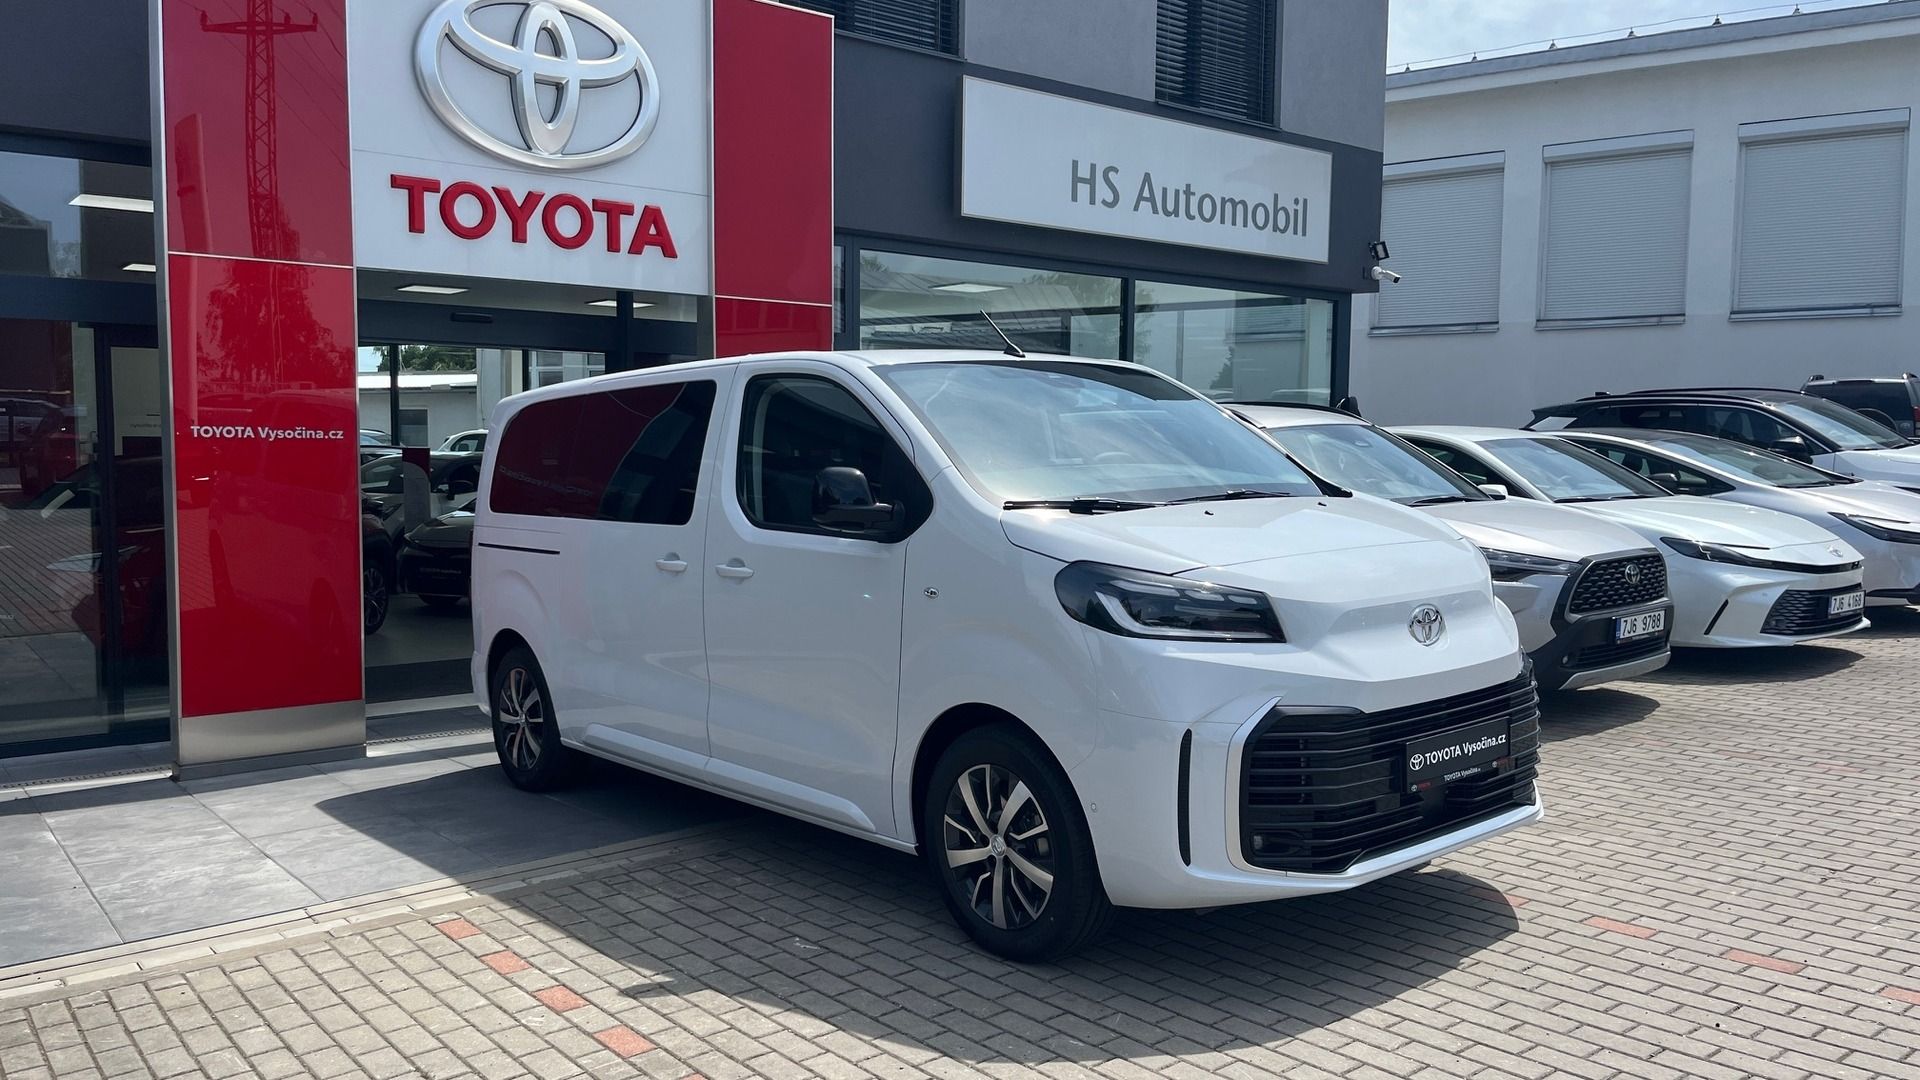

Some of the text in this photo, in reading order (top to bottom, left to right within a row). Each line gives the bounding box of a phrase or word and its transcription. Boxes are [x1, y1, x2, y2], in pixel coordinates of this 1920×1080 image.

[1071, 159, 1308, 237] HS Automobil
[390, 173, 678, 259] TOYOTA
[191, 425, 344, 441] TOYOTA Vysočina.cz
[1832, 596, 1845, 612] 7J6
[1622, 612, 1661, 637] 7J6 9788
[1425, 734, 1507, 765] TOYOTA Vysočina.cz
